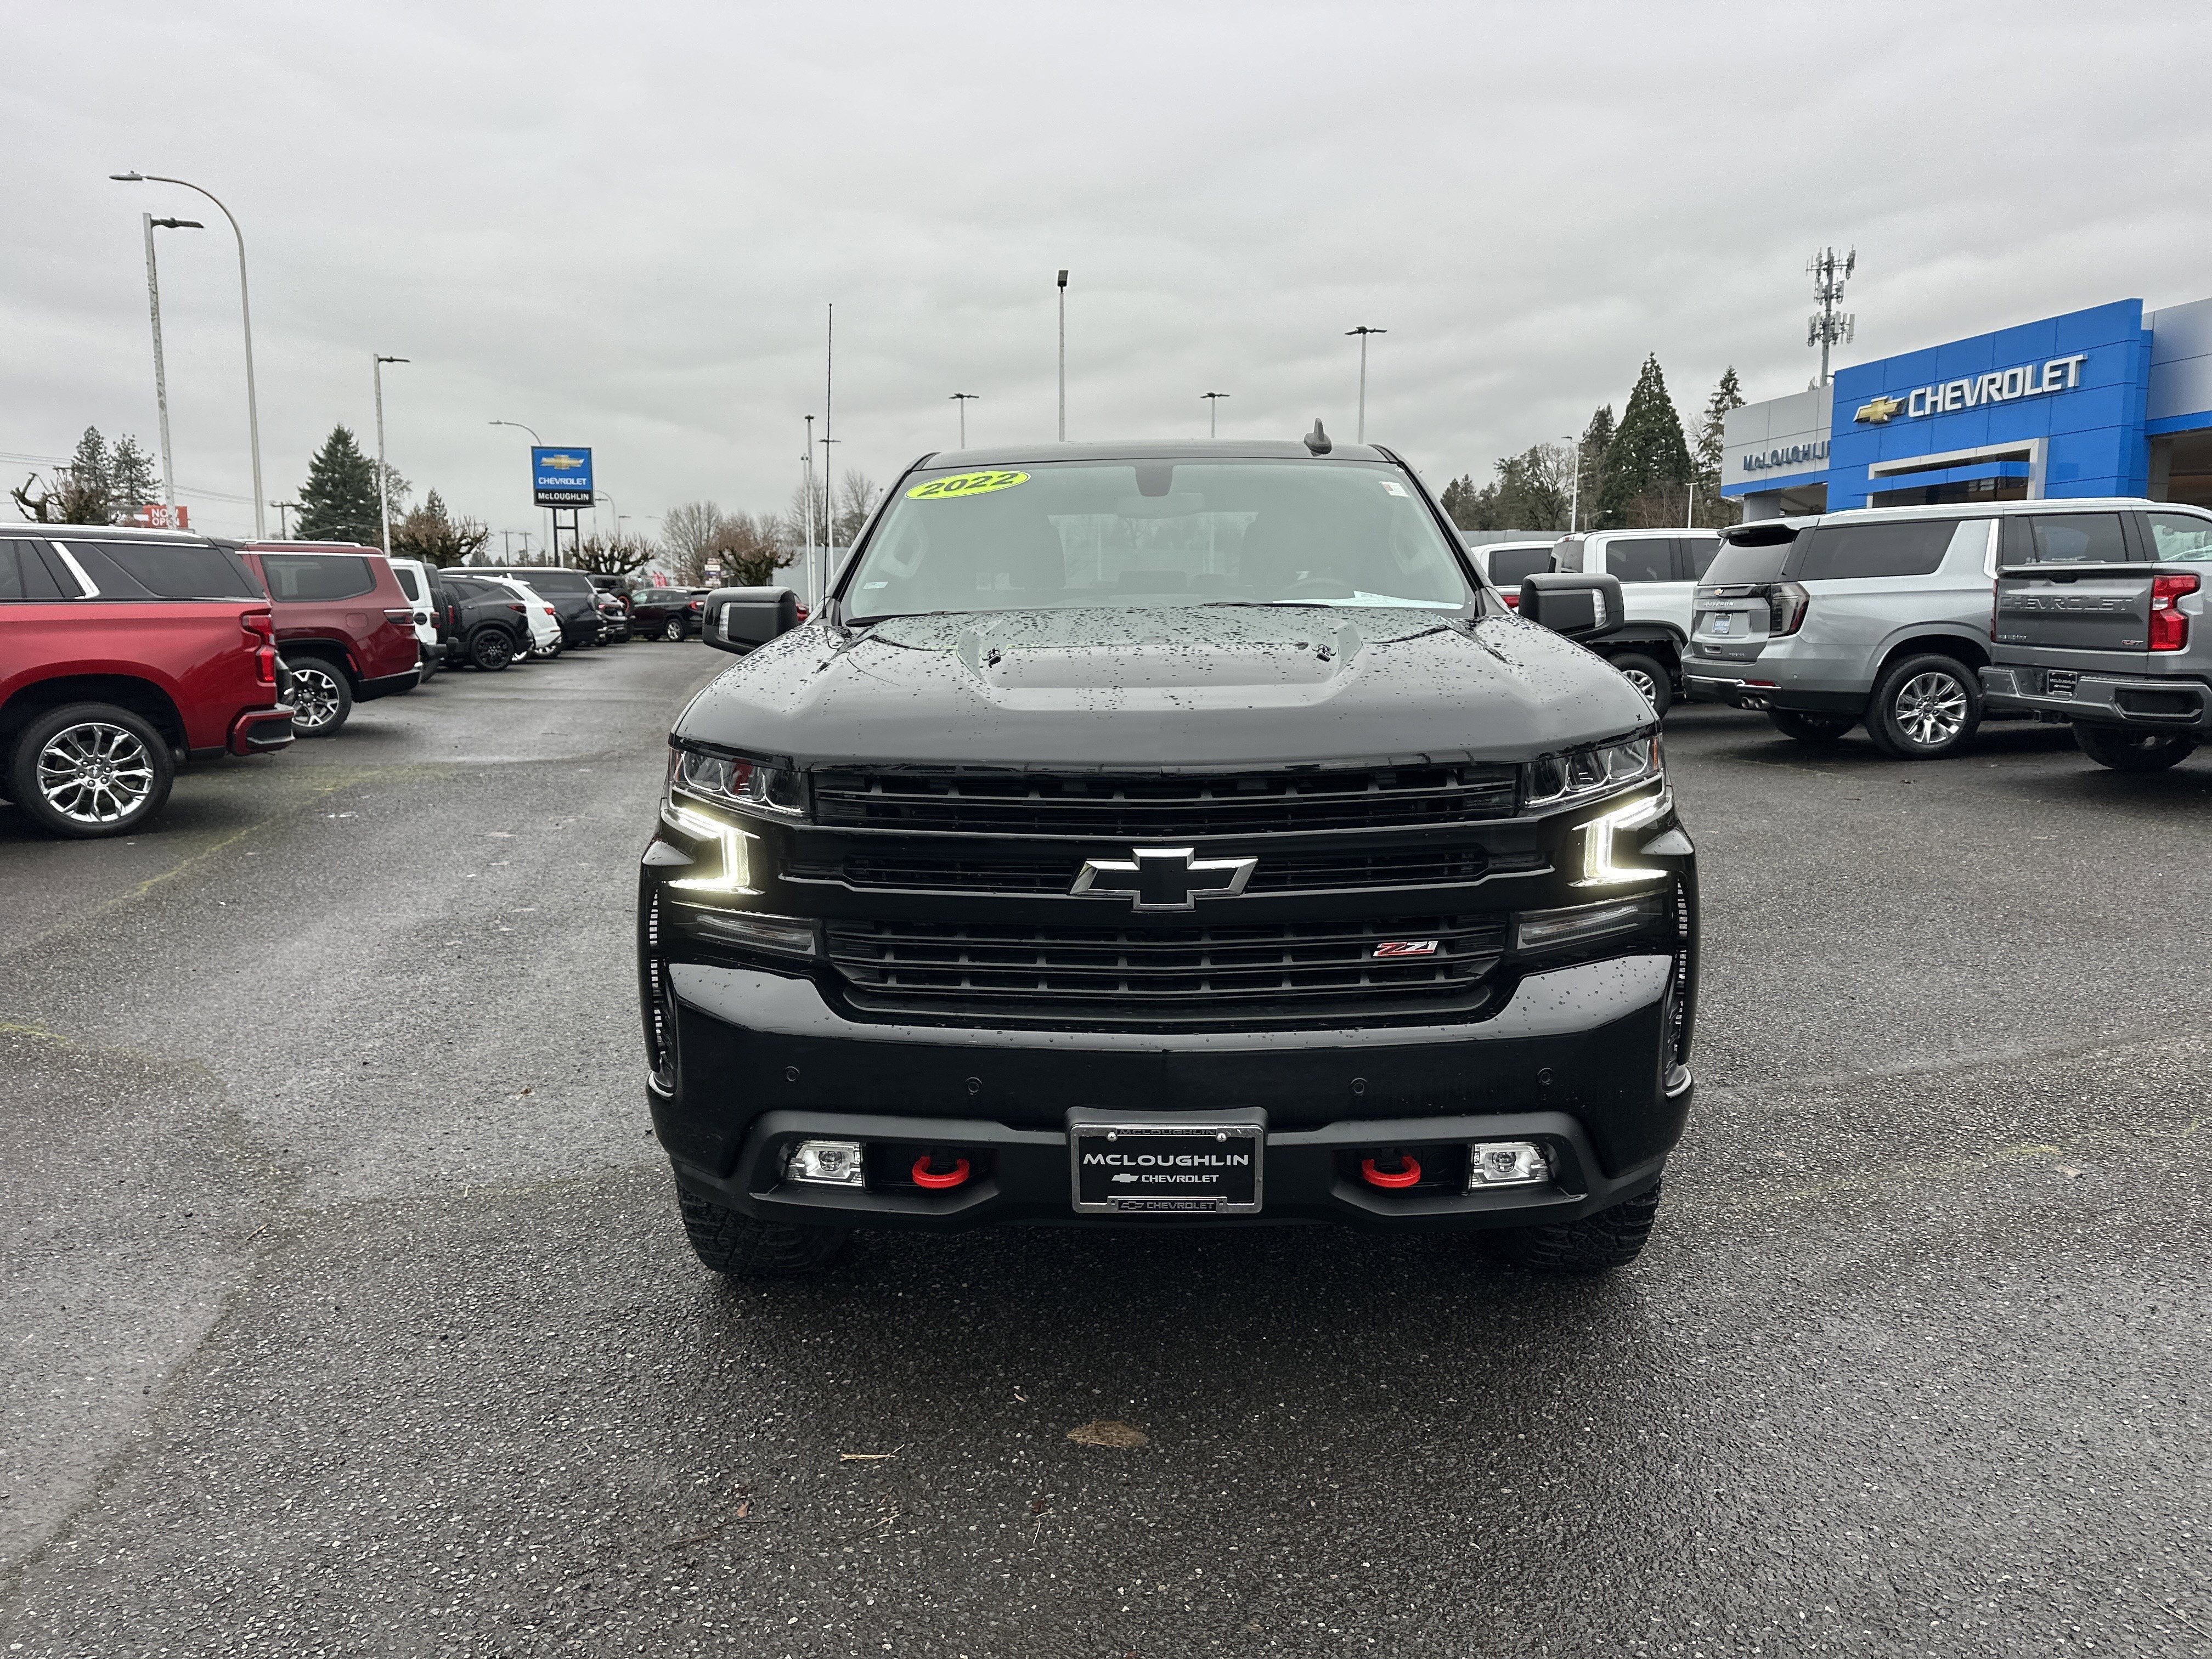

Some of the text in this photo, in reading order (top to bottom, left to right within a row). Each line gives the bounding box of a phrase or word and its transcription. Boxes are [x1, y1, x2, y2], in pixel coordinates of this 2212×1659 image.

[1908, 353, 2088, 417] CHEVROLET
[538, 477, 587, 486] CHEVROLET
[917, 473, 1018, 497] 2022
[538, 492, 589, 500] McLOUGHLIN
[151, 508, 179, 518] NO
[2000, 596, 2134, 611] CHEVROLET
[1373, 940, 1438, 957] Z71
[1083, 1153, 1249, 1166] MCLOUGHLIN
[1142, 1175, 1220, 1183] CHEVROLET
[1146, 1201, 1215, 1210] CHEVROLET
